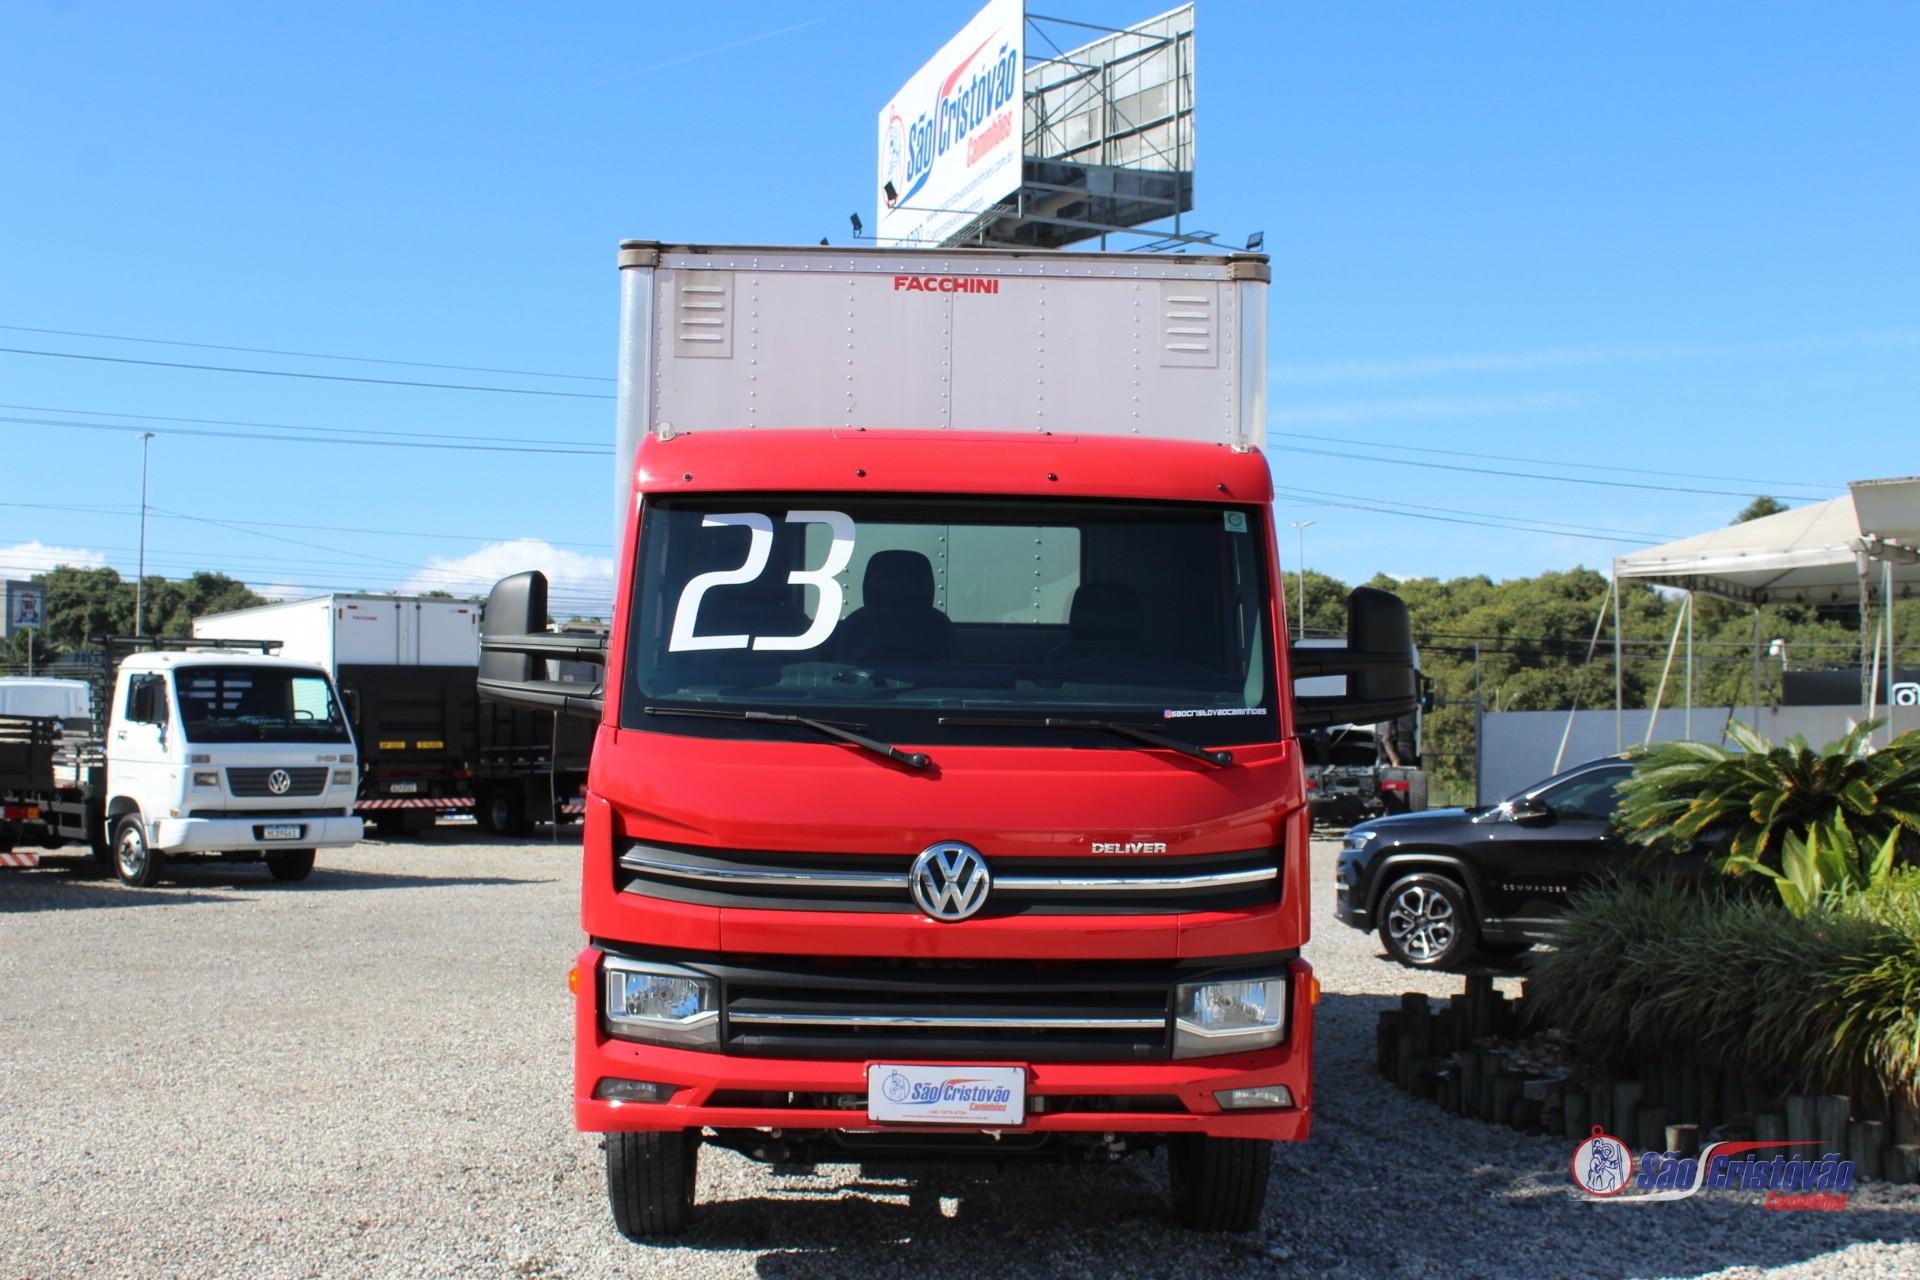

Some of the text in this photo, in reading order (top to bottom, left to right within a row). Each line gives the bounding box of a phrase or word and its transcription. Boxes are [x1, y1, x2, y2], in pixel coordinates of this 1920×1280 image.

[907, 41, 1016, 182] São Cristóvão
[966, 109, 1012, 168] Chões
[894, 275, 999, 294] FACCHINI
[669, 510, 856, 652] 23
[1091, 842, 1167, 854] DELIVER
[911, 1082, 1011, 1103] São Cristóvão
